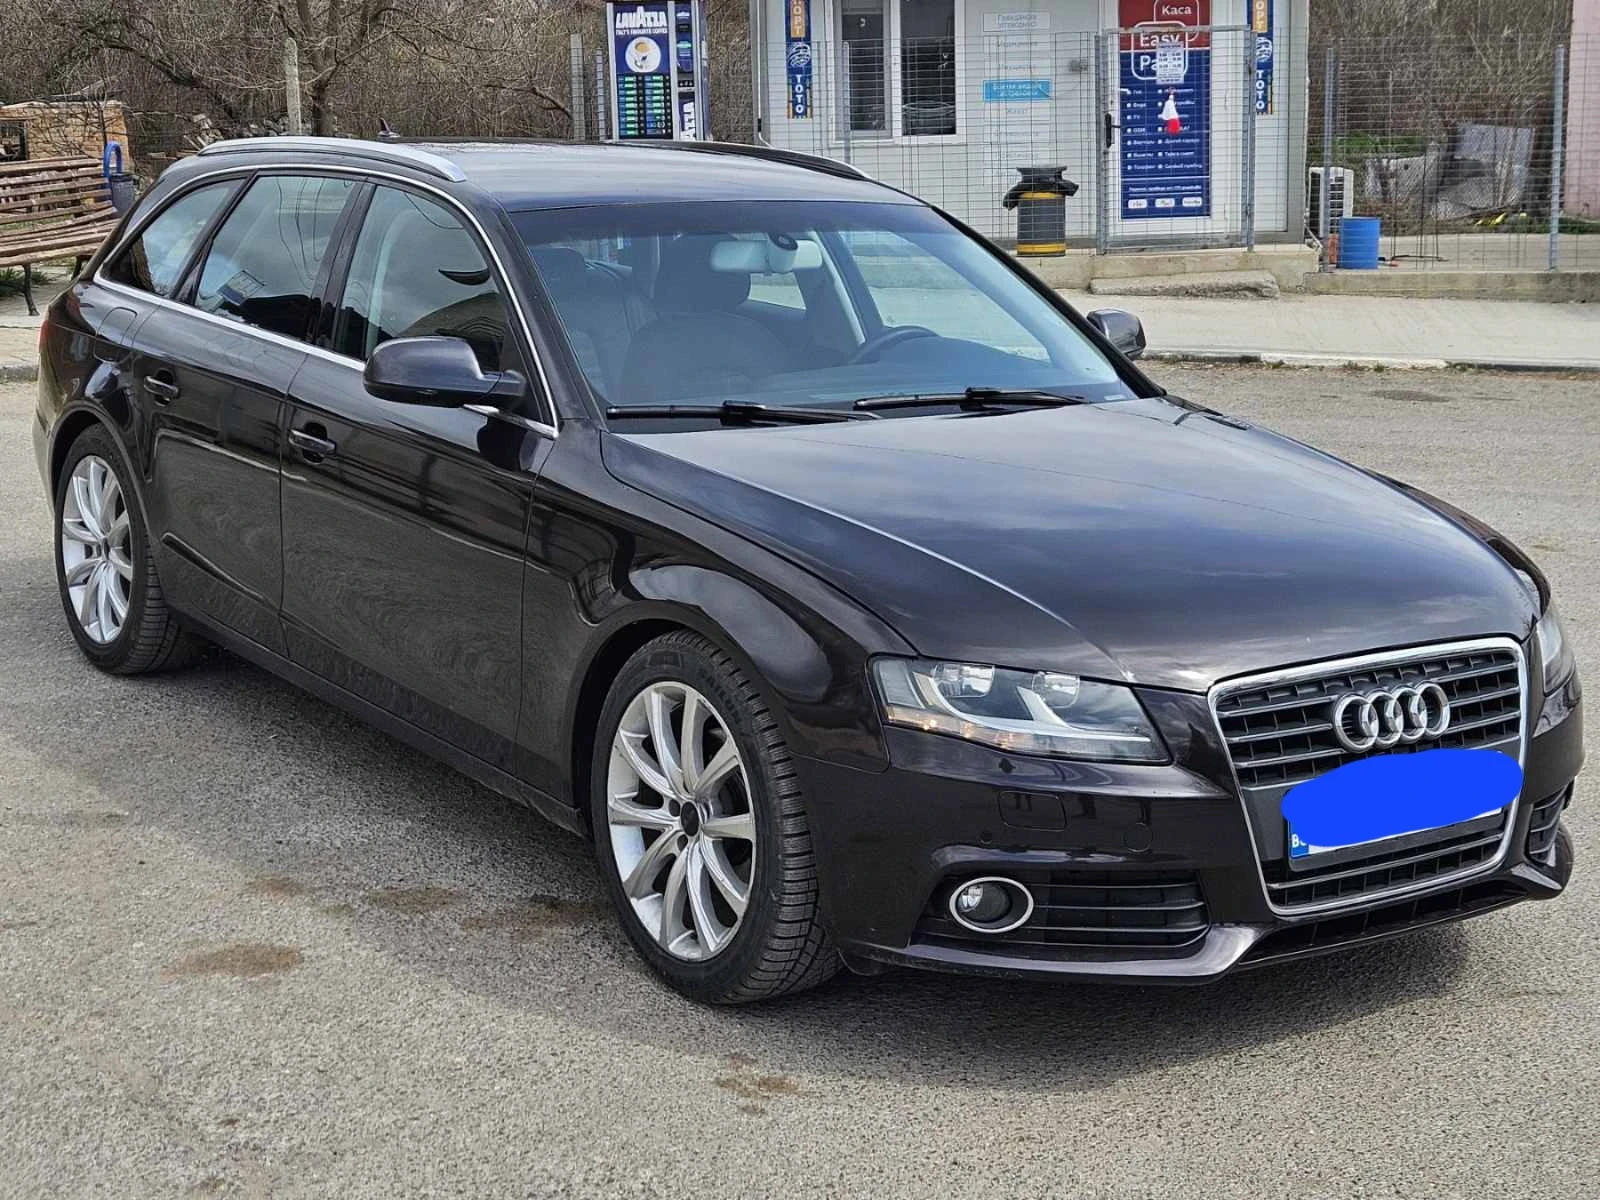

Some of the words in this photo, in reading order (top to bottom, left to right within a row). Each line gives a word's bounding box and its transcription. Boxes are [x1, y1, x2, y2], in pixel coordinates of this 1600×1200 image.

[616, 6, 667, 28] LAVAZZA
[793, 0, 803, 34] ОРТ
[1162, 5, 1191, 16] Каса
[1140, 32, 1181, 48] Easy
[1140, 56, 1158, 72] Pa
